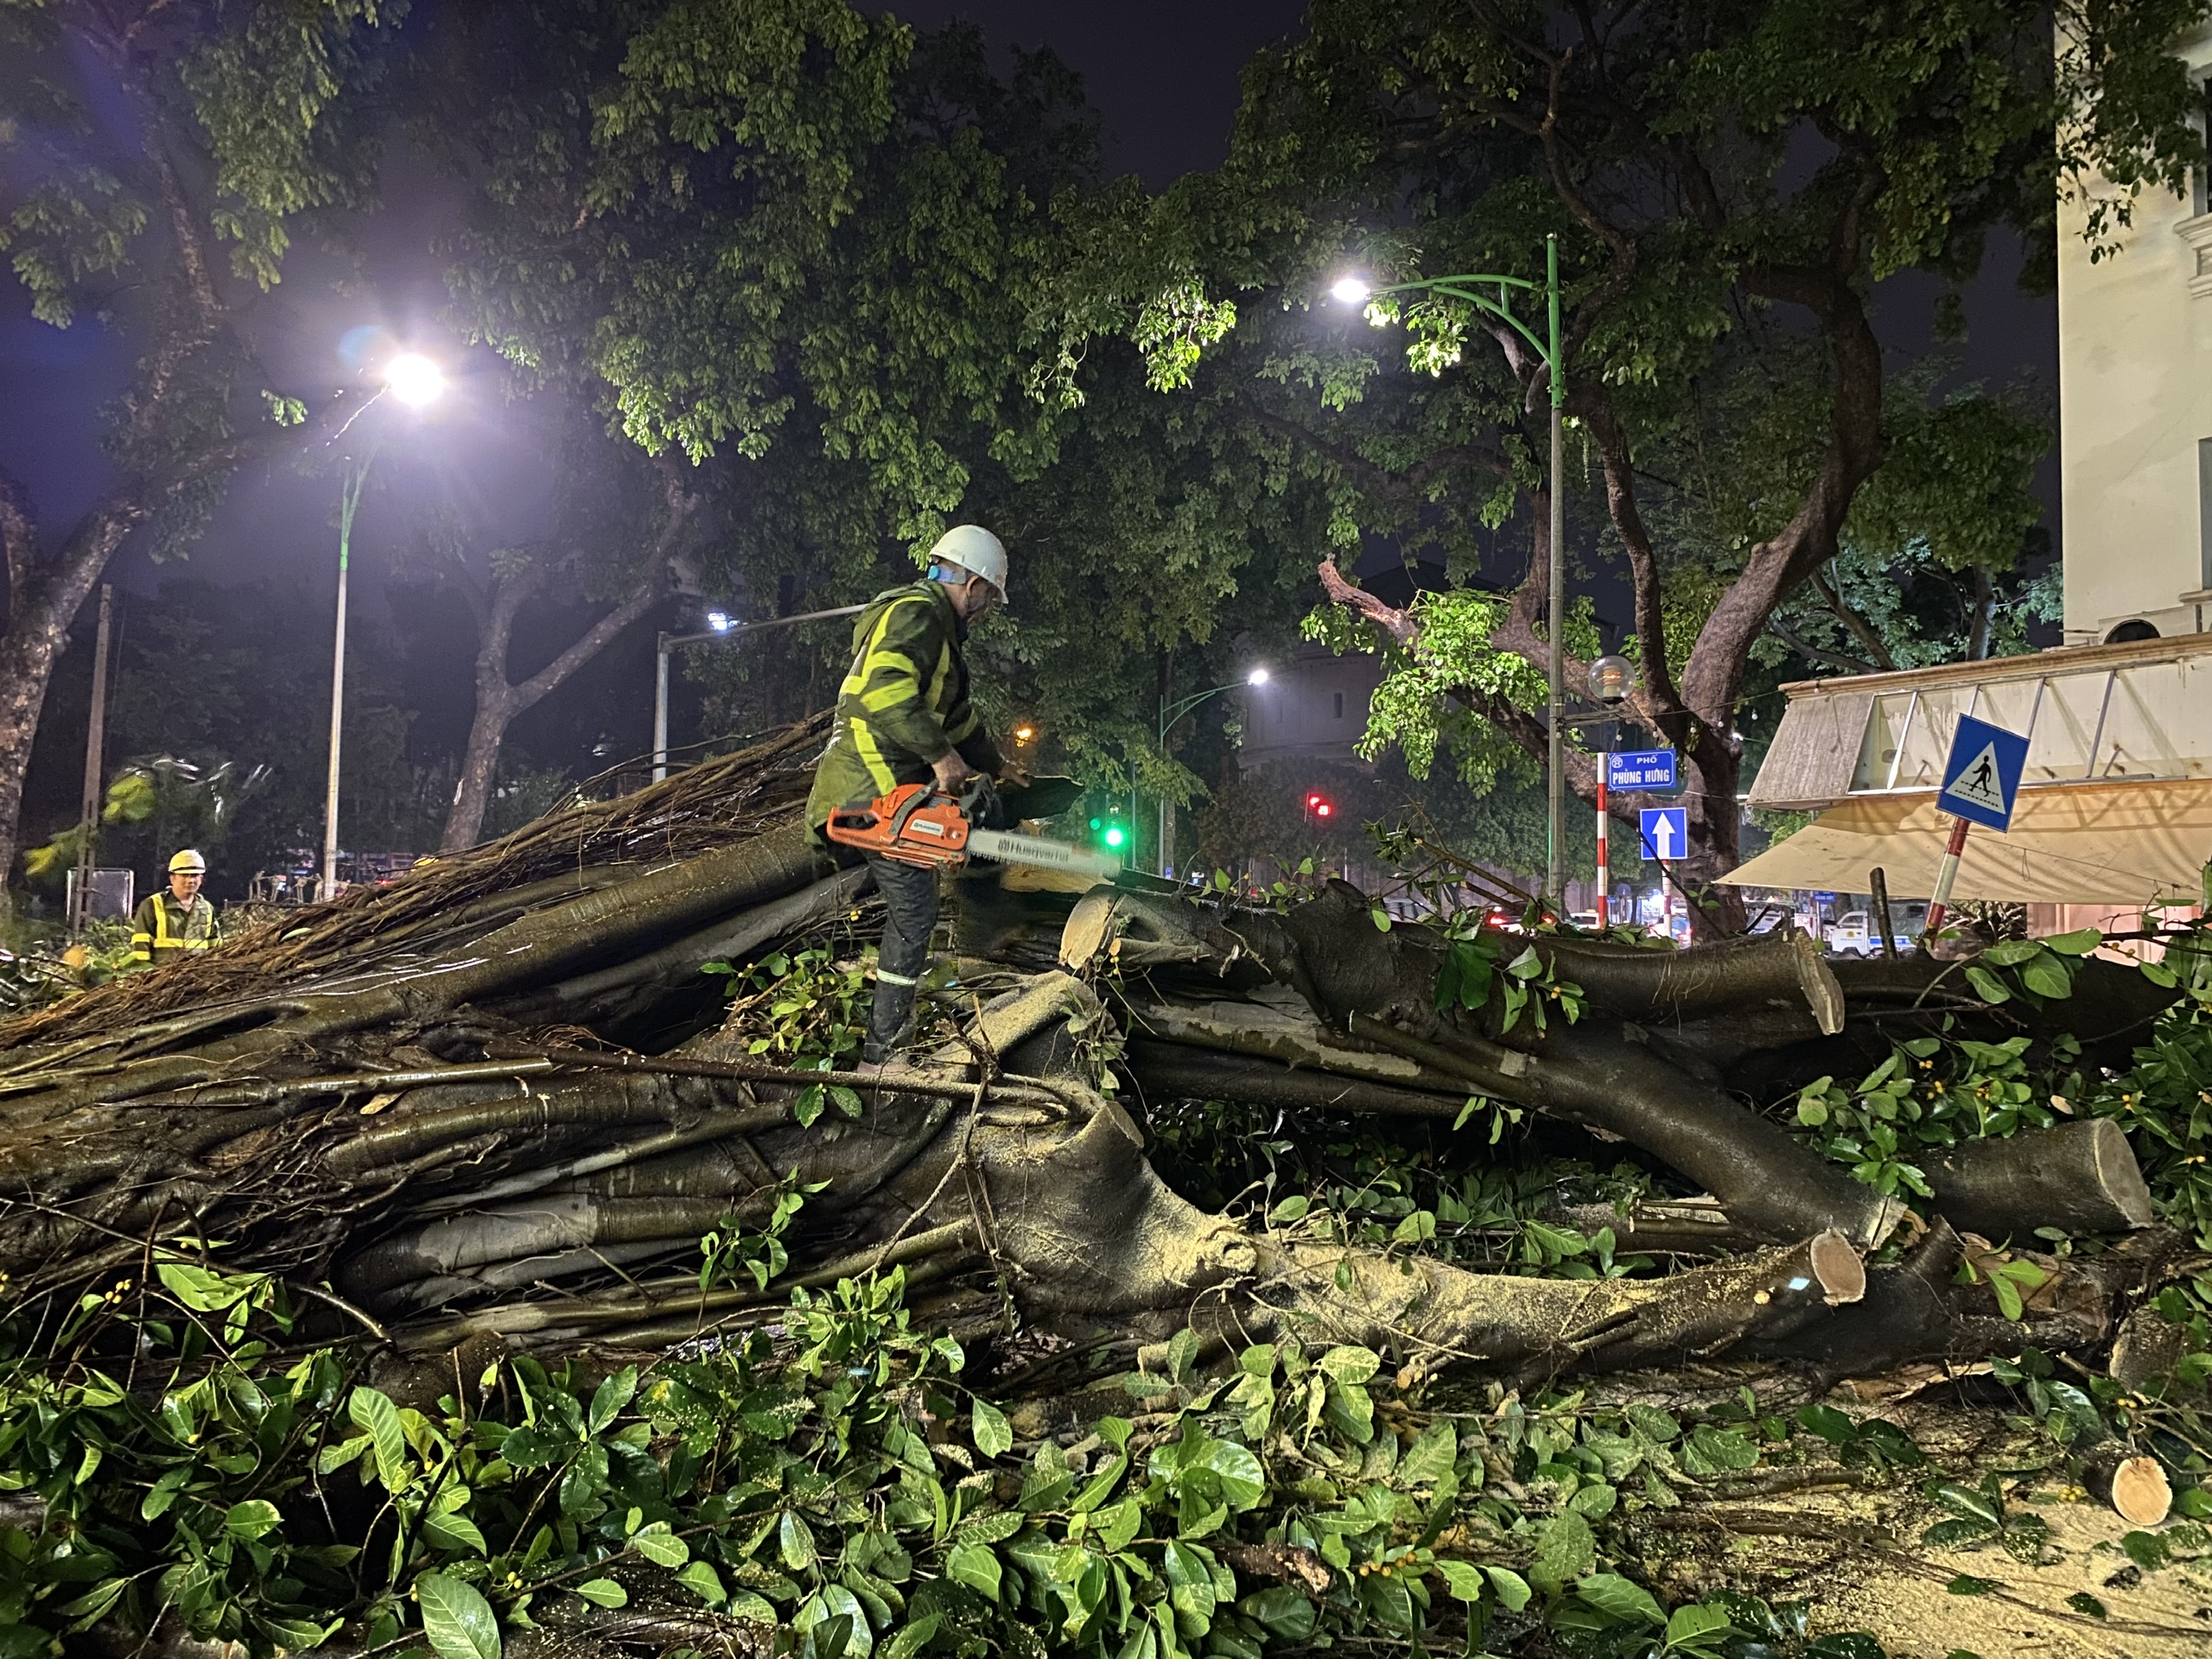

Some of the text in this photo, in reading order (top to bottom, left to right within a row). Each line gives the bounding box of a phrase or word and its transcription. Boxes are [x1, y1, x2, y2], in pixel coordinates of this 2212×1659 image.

[1637, 754, 1658, 764] PHỐ
[1612, 768, 1669, 785] PHÙNG HƯNG
